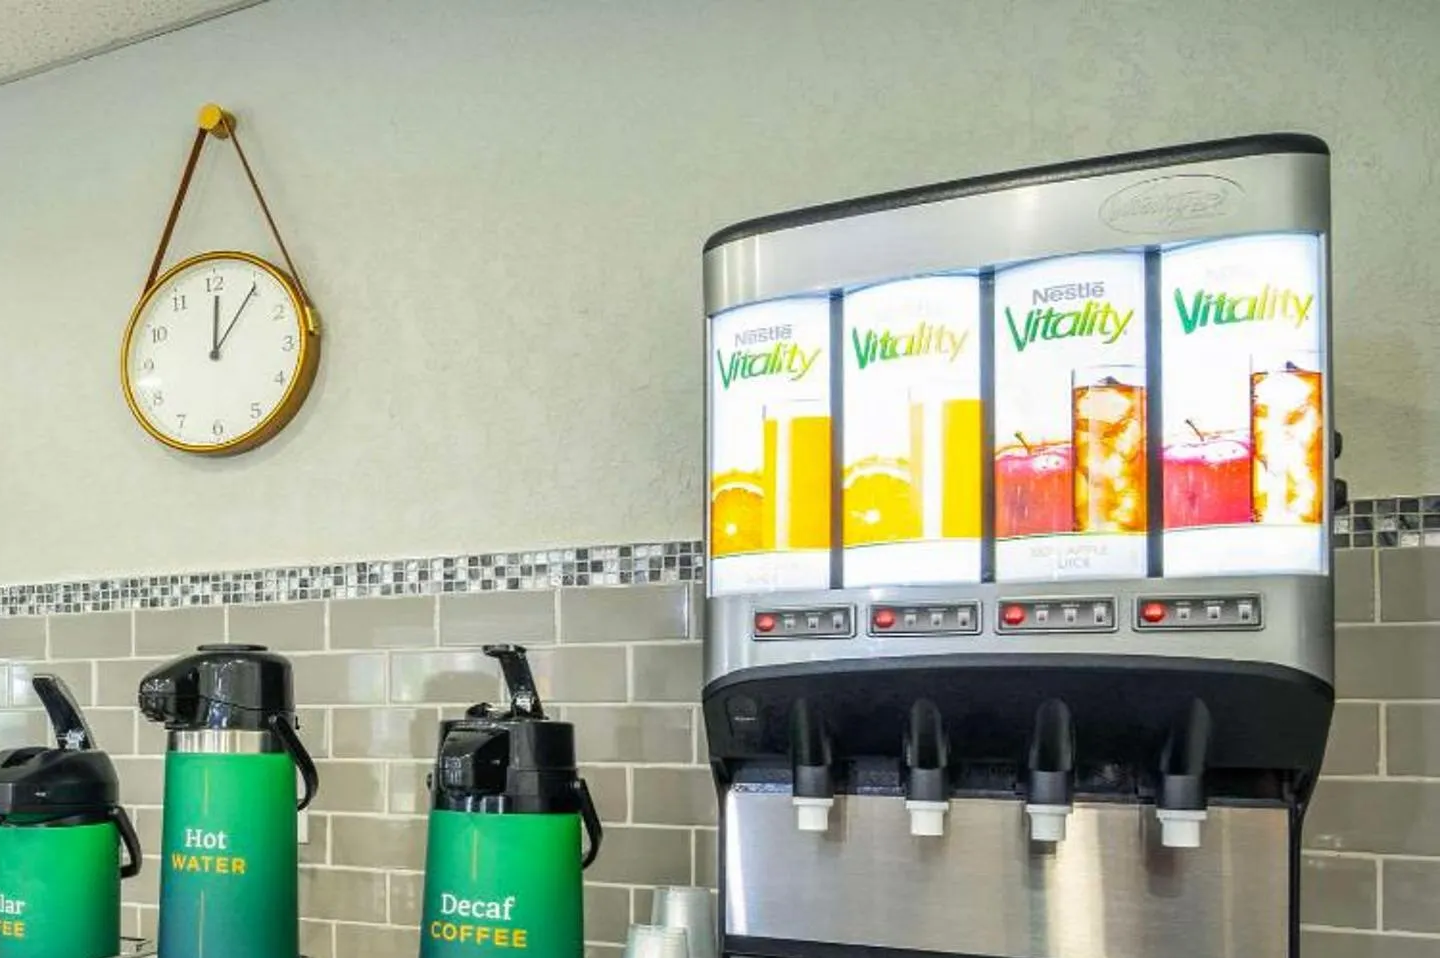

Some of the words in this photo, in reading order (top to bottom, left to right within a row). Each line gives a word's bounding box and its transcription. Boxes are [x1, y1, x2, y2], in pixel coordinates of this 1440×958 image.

[205, 276, 224, 293] 12
[172, 295, 187, 312] 11
[1173, 283, 1314, 335] Vitality
[273, 305, 285, 320] 2
[1004, 299, 1134, 352] Vitality
[151, 327, 168, 344] 10
[282, 335, 295, 352] 3
[851, 320, 970, 370] Vitality
[717, 341, 822, 390] Vitality
[274, 370, 285, 386] 4
[250, 403, 263, 419] 5
[176, 414, 187, 429] 7
[212, 419, 224, 436] 6
[185, 828, 228, 850] Hot
[171, 852, 246, 875] WATER
[440, 893, 516, 921] Decaf
[431, 920, 527, 949] COFFEE
